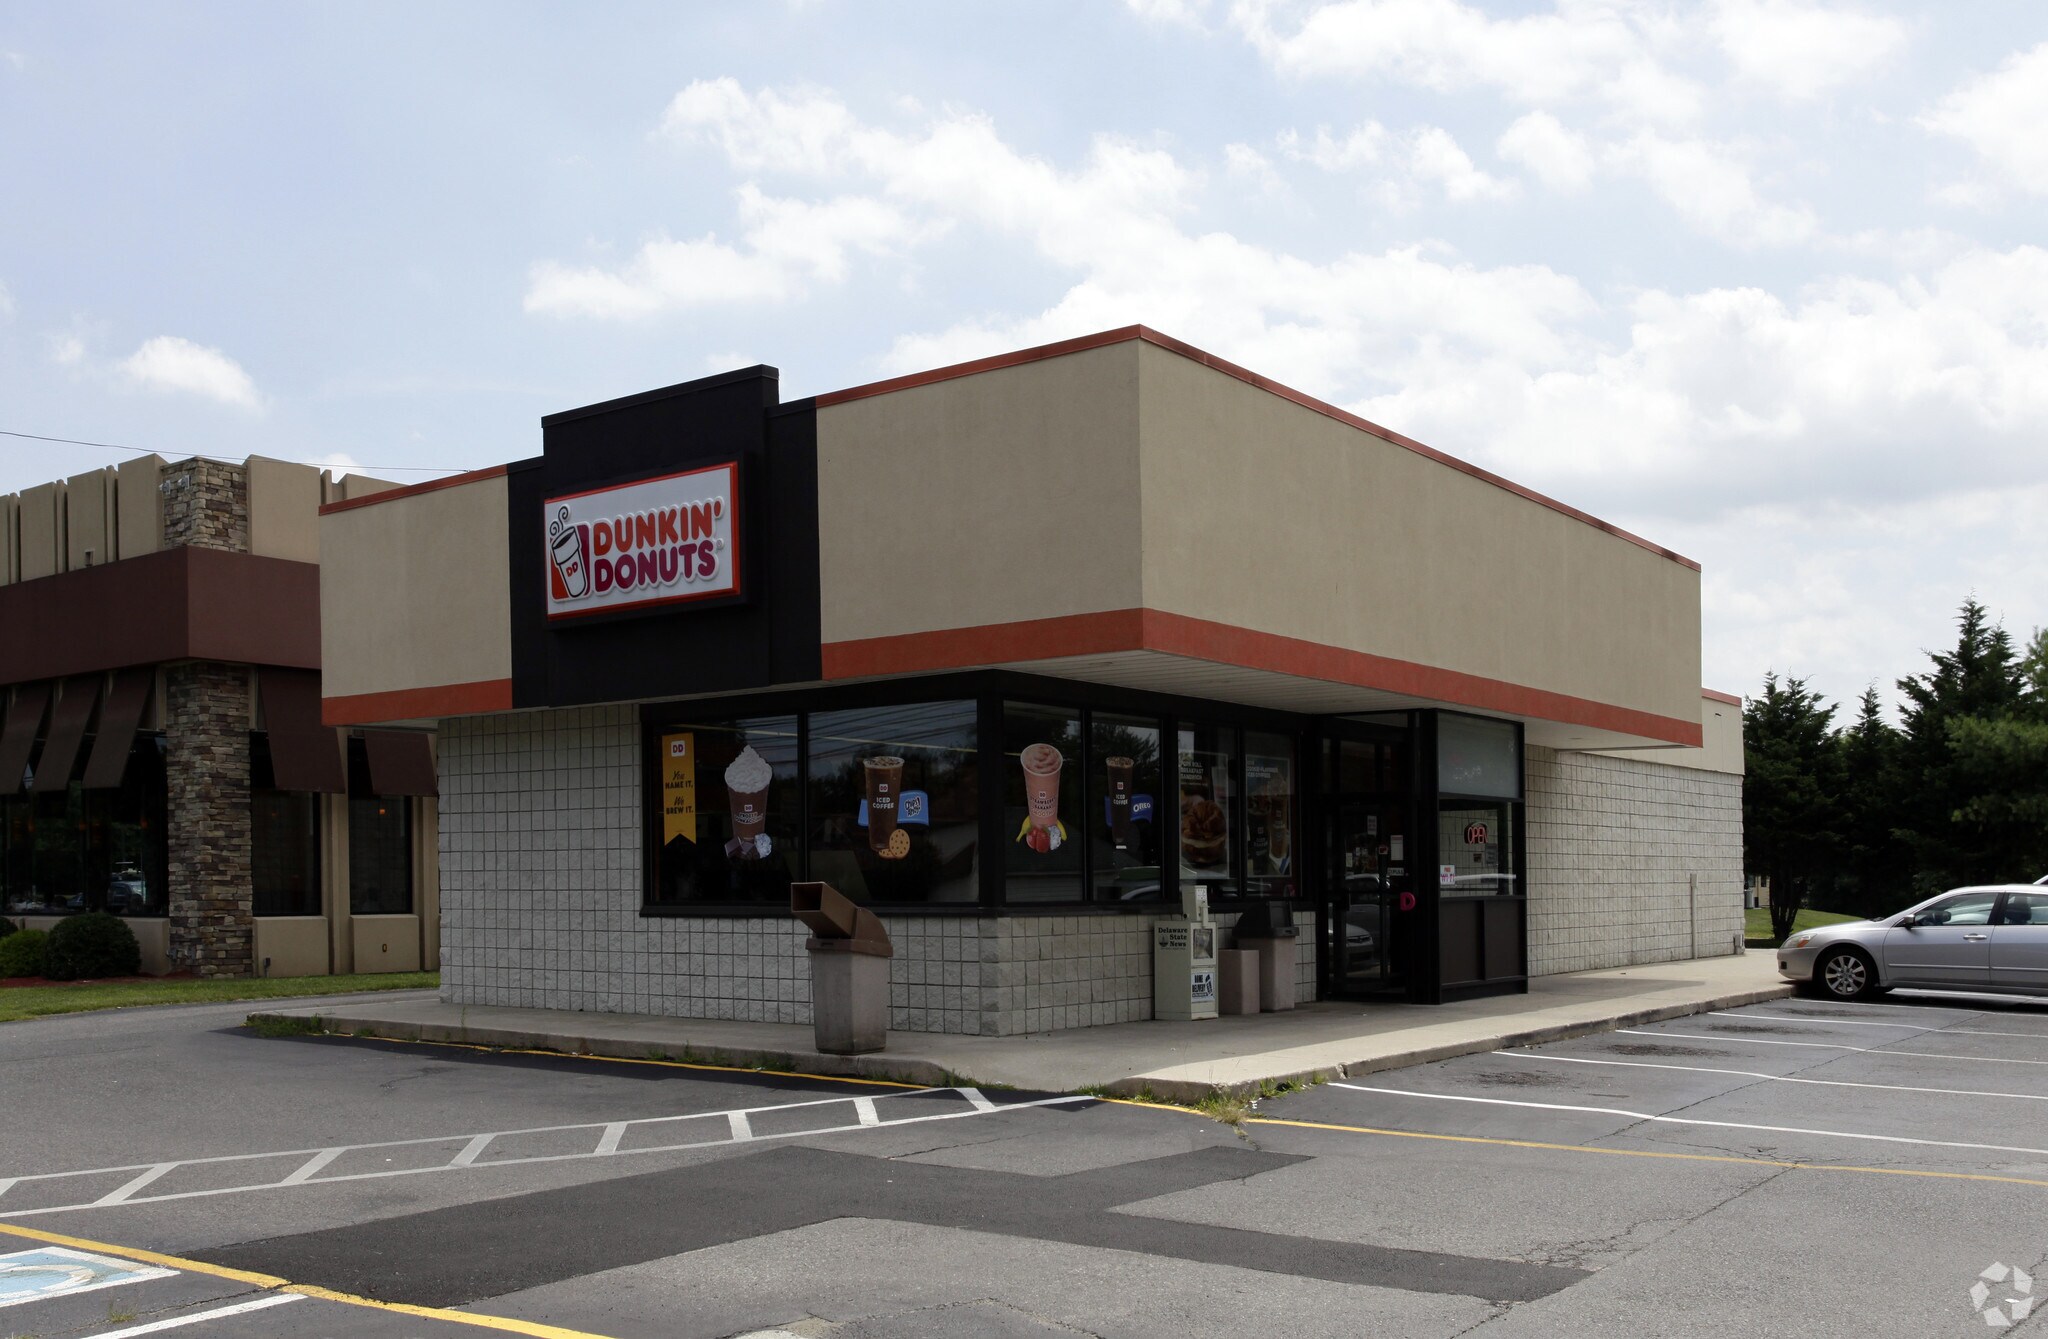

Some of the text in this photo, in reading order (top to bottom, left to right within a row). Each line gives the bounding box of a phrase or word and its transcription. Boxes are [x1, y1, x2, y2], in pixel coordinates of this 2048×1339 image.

[593, 500, 722, 556] DUNKIN'
[566, 561, 579, 577] DD
[594, 539, 716, 593] DONUTS
[672, 744, 684, 754] DD
[672, 770, 685, 780] You
[665, 781, 684, 789] NAME
[666, 806, 684, 815] BREW
[872, 802, 895, 810] COFFEE
[1133, 802, 1151, 812] OREO
[1467, 827, 1488, 845] OPEN
[1399, 891, 1417, 912] D
